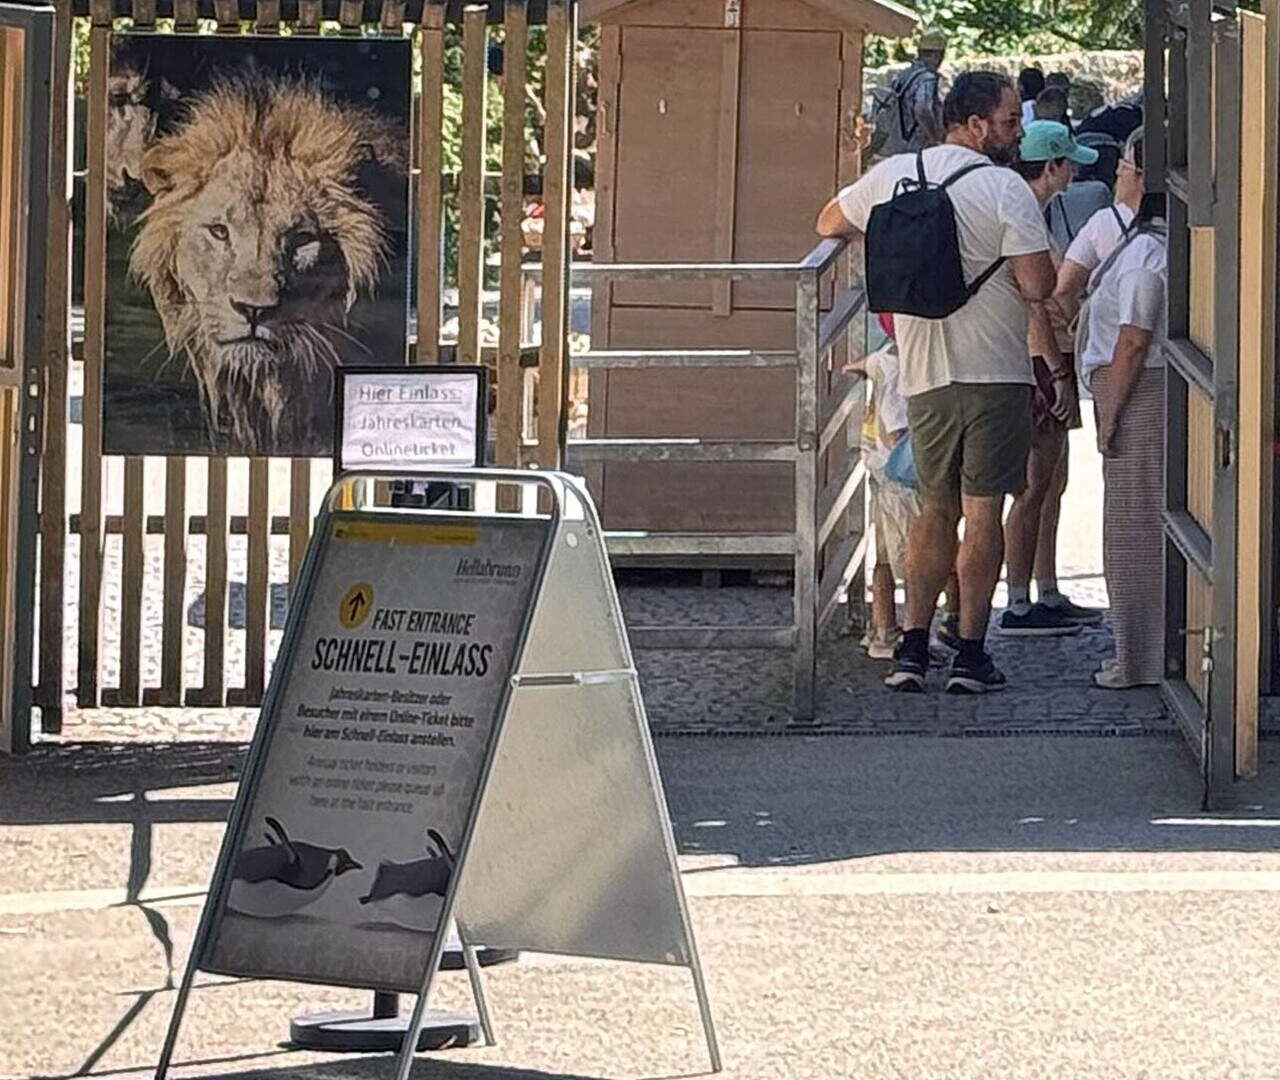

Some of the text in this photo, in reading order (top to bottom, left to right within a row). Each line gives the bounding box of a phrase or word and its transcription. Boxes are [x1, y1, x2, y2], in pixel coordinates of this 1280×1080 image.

[359, 384, 393, 401] Hier
[372, 608, 476, 636] FAST ENTRANCE
[312, 637, 492, 677] SCHNELL-EINLASS
